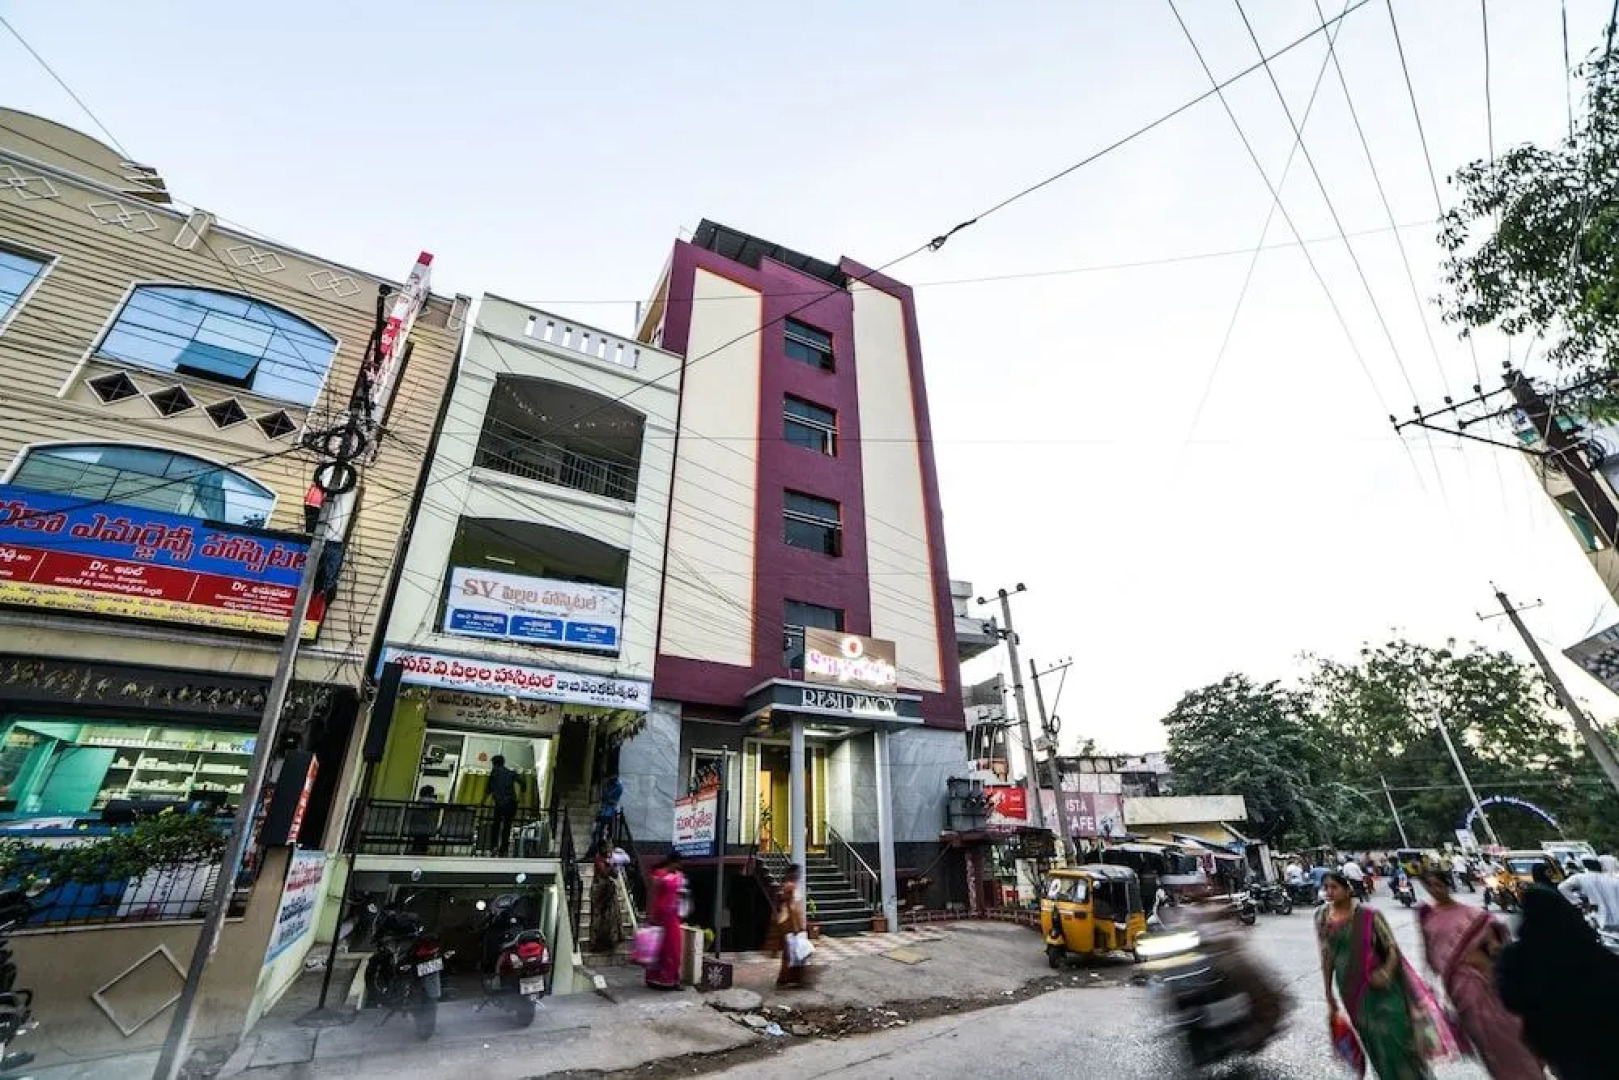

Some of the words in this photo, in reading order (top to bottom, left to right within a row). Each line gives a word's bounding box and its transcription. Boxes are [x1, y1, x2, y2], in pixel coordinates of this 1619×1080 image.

[89, 560, 108, 572] Dr.
[231, 581, 248, 592] Dr.
[462, 577, 501, 598] SV
[801, 689, 897, 713] RESIDENCY
[1066, 815, 1094, 832] AFE
